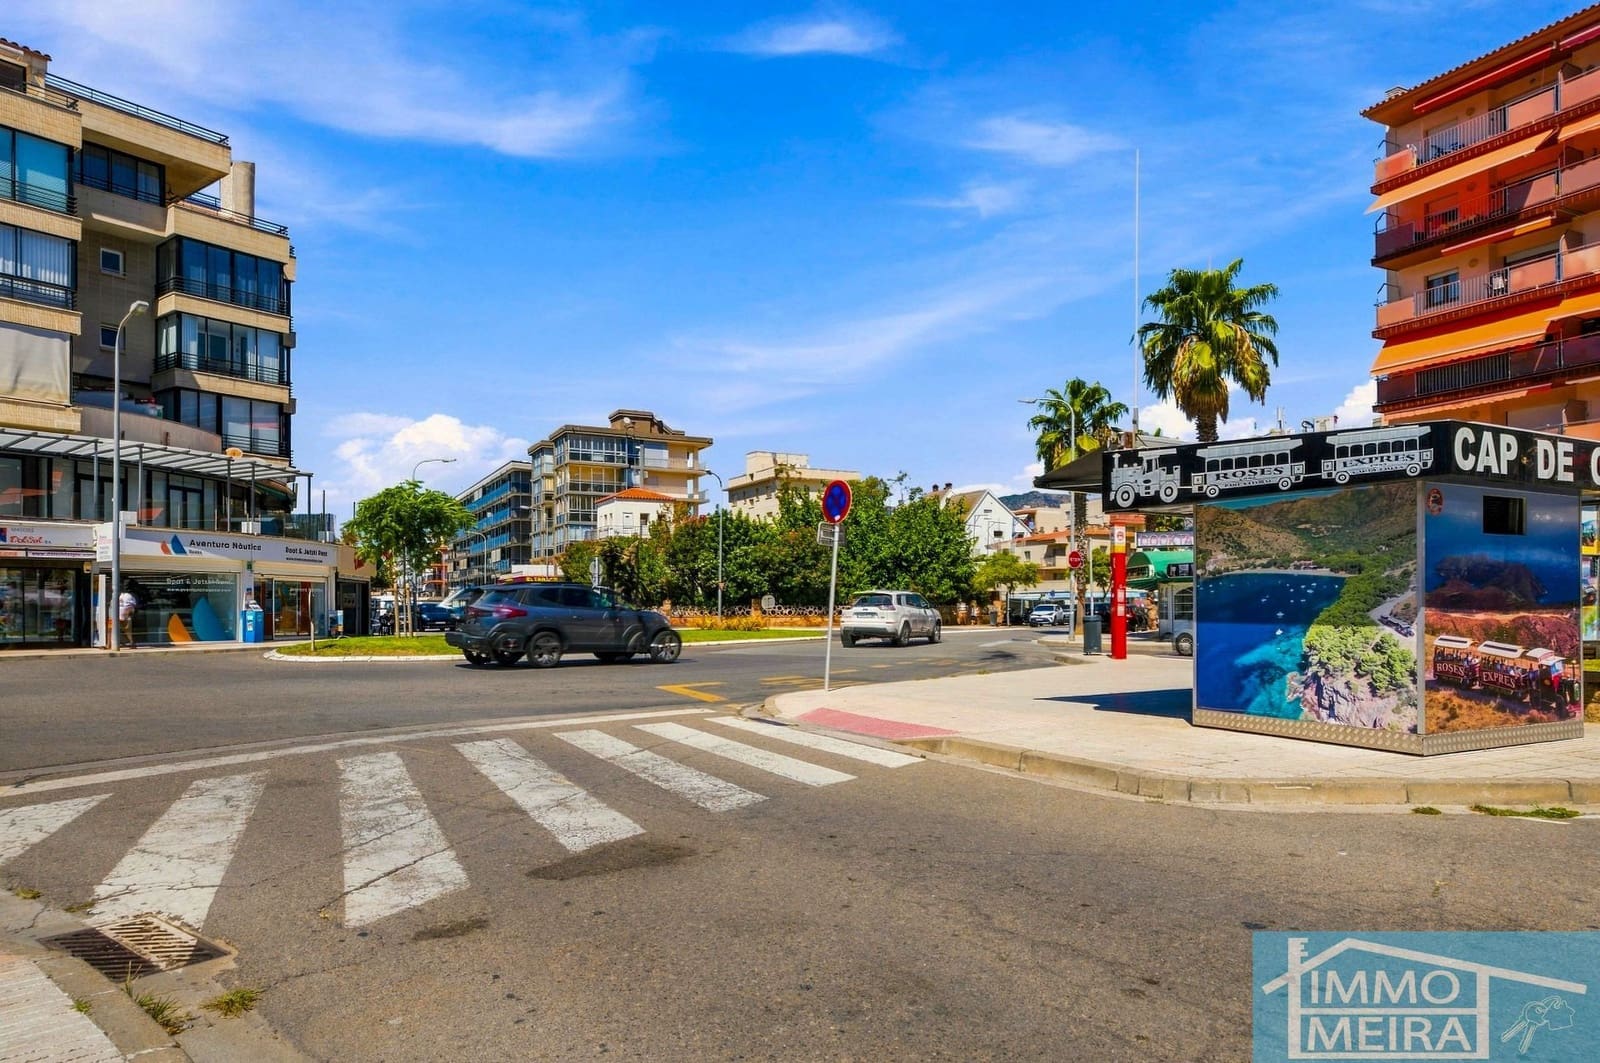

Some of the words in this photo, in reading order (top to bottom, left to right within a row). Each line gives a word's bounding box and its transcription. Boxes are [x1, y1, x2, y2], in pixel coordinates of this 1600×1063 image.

[1342, 453, 1416, 468] EXPRES
[1454, 426, 1518, 475] CAP
[1537, 439, 1574, 482] DE
[1215, 466, 1285, 481] ROSES
[189, 539, 230, 549] Aventura
[1436, 662, 1465, 676] ROSES
[1482, 671, 1516, 688] EXPRES
